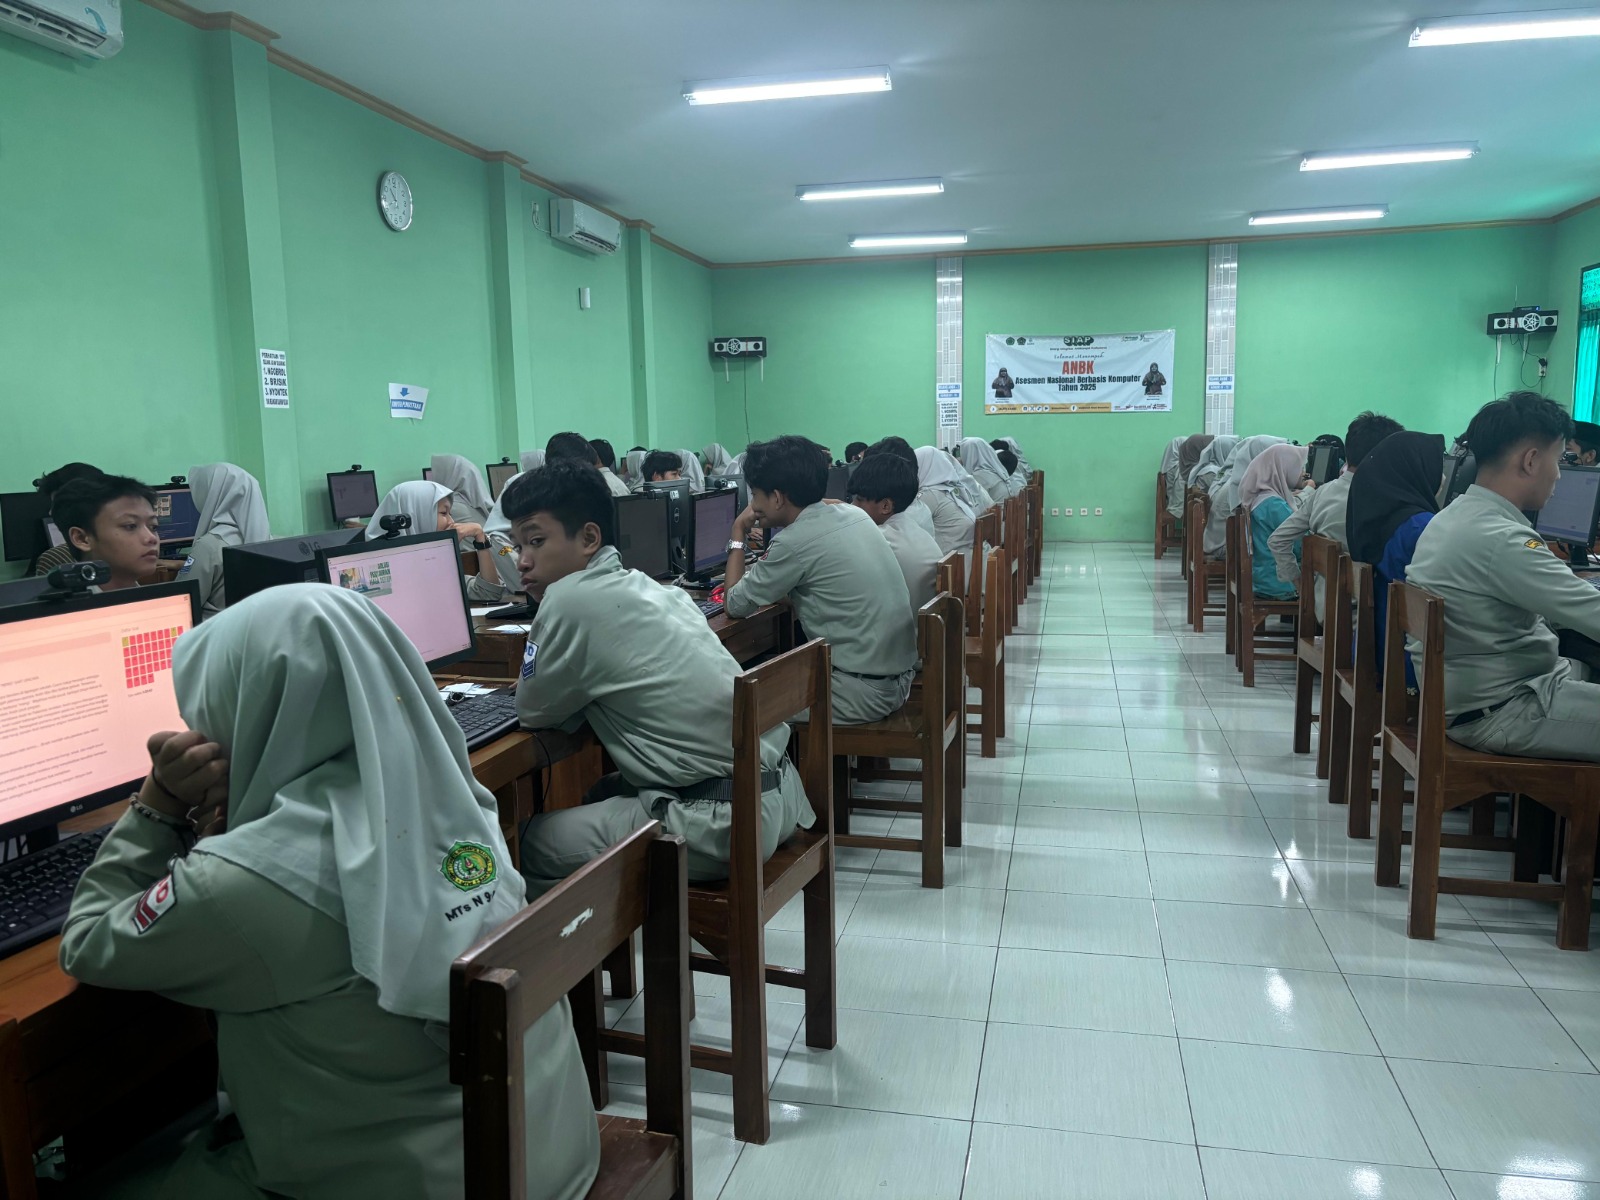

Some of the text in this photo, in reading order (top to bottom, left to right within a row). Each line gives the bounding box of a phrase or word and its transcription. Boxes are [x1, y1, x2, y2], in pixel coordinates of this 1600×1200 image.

[1064, 336, 1093, 345] SIAP
[1062, 360, 1094, 375] ANBK
[264, 377, 270, 386] 2.
[1015, 374, 1141, 385] Asesmen Nasional Berbasis Komputer
[1058, 383, 1097, 392] Tahun 2025
[444, 903, 472, 922] MTs
[471, 895, 484, 907] N
